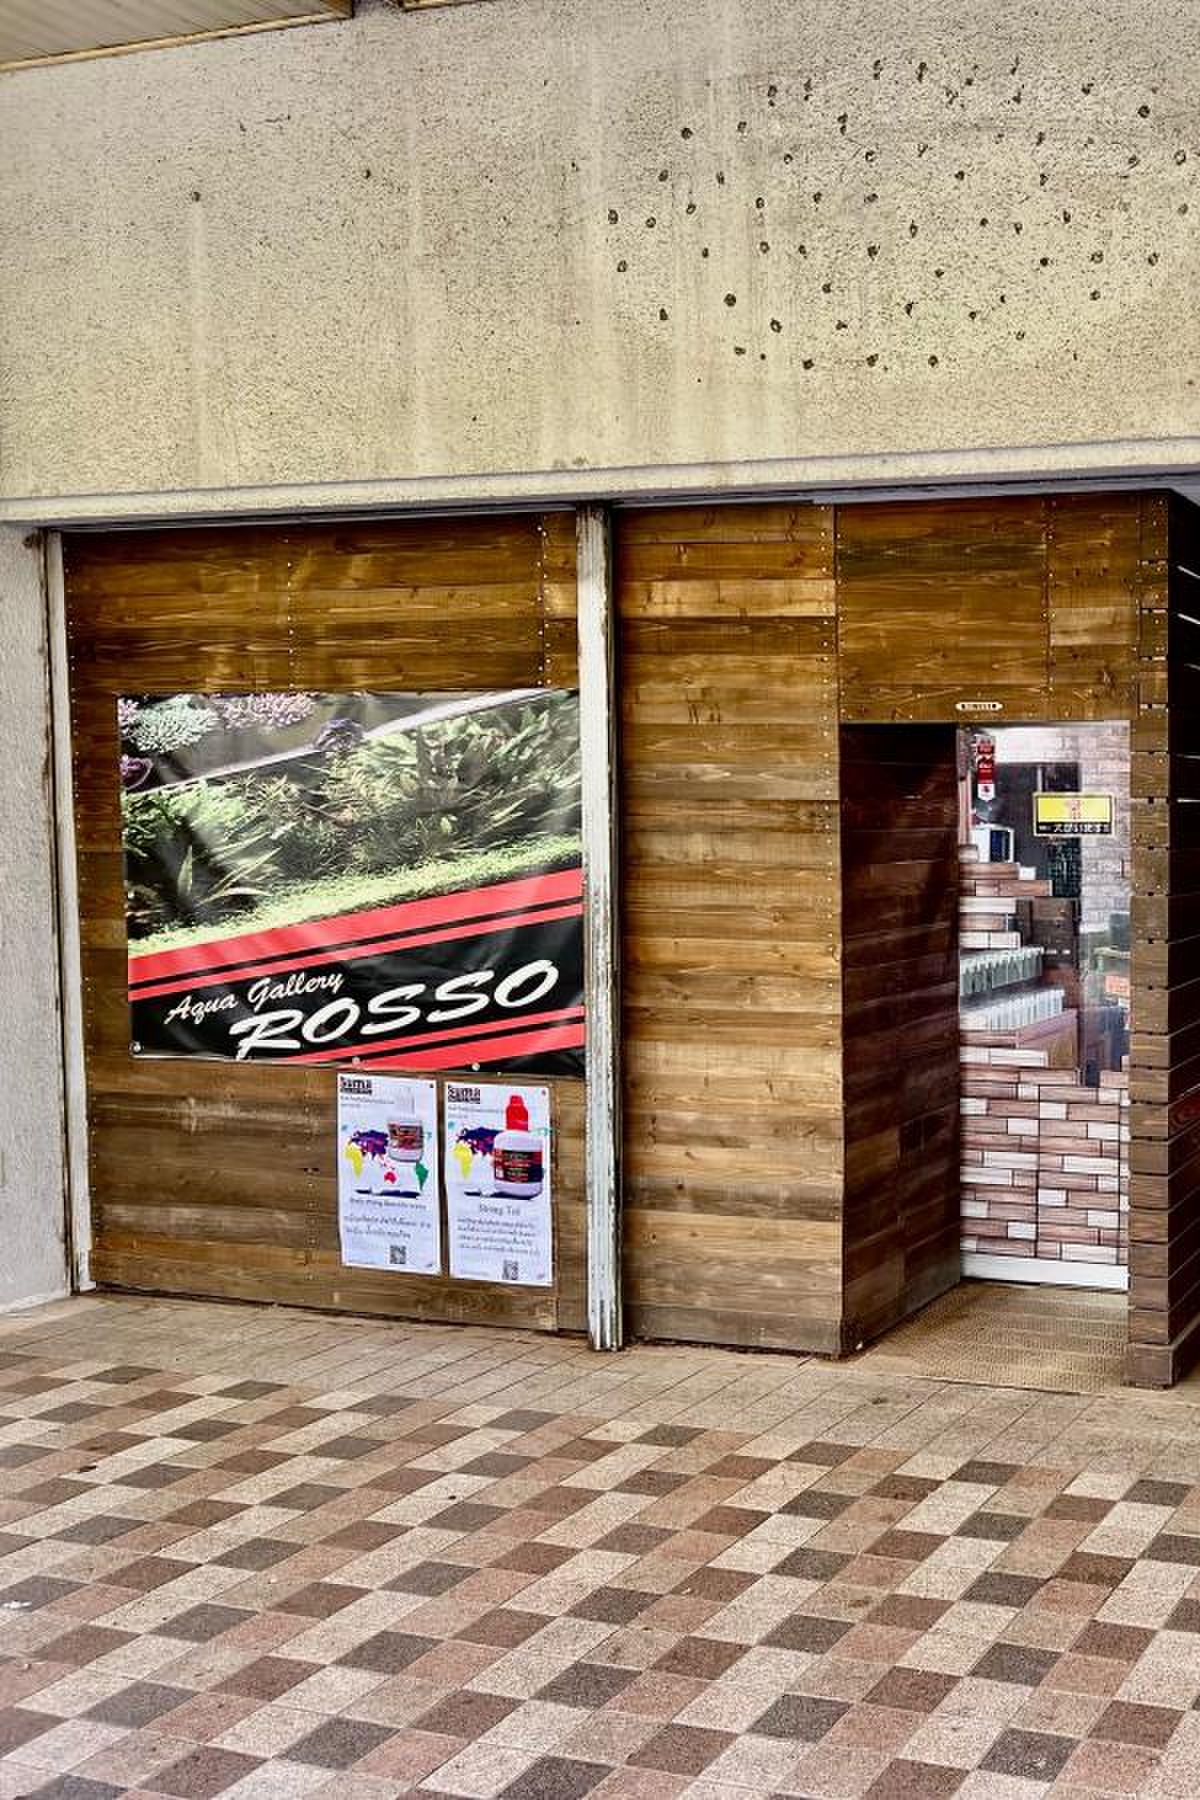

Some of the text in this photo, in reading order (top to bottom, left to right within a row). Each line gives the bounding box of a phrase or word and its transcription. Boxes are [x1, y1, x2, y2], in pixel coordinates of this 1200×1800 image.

[164, 970, 344, 1024] Aqua Gallery
[229, 959, 560, 1061] ROSSO
